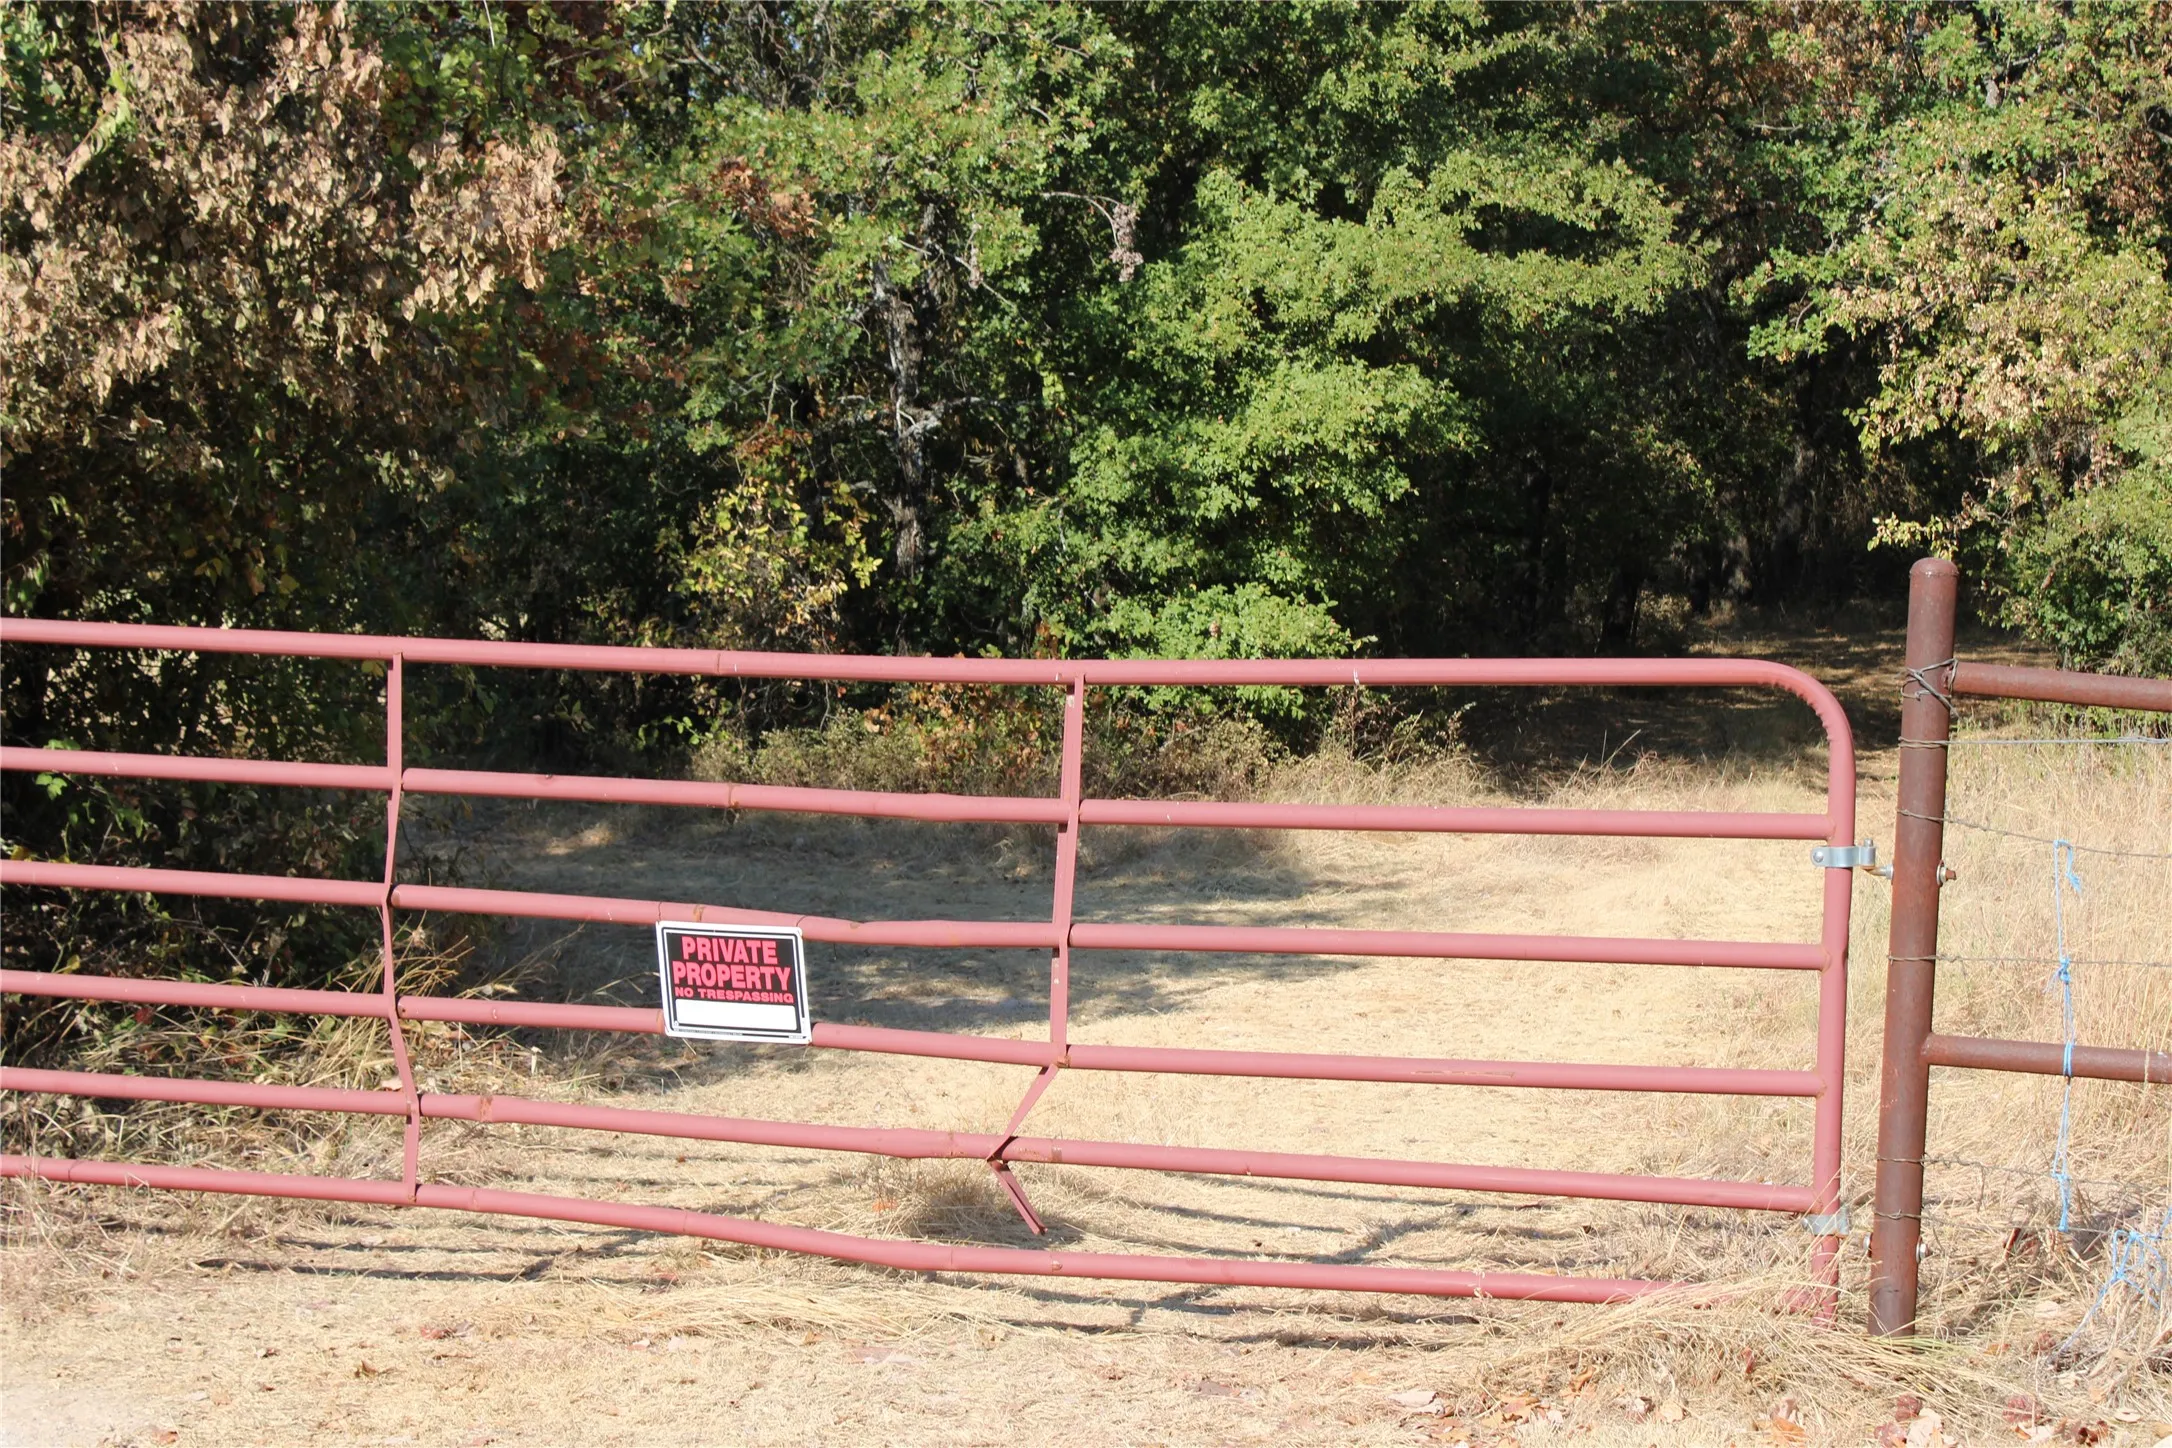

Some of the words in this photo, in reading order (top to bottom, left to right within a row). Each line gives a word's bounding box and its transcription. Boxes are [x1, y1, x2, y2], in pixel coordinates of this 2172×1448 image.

[681, 936, 778, 965] PRIVATE
[672, 960, 791, 991] PROPERTY
[674, 986, 694, 998] NO
[697, 988, 794, 1004] TRESPASSING
